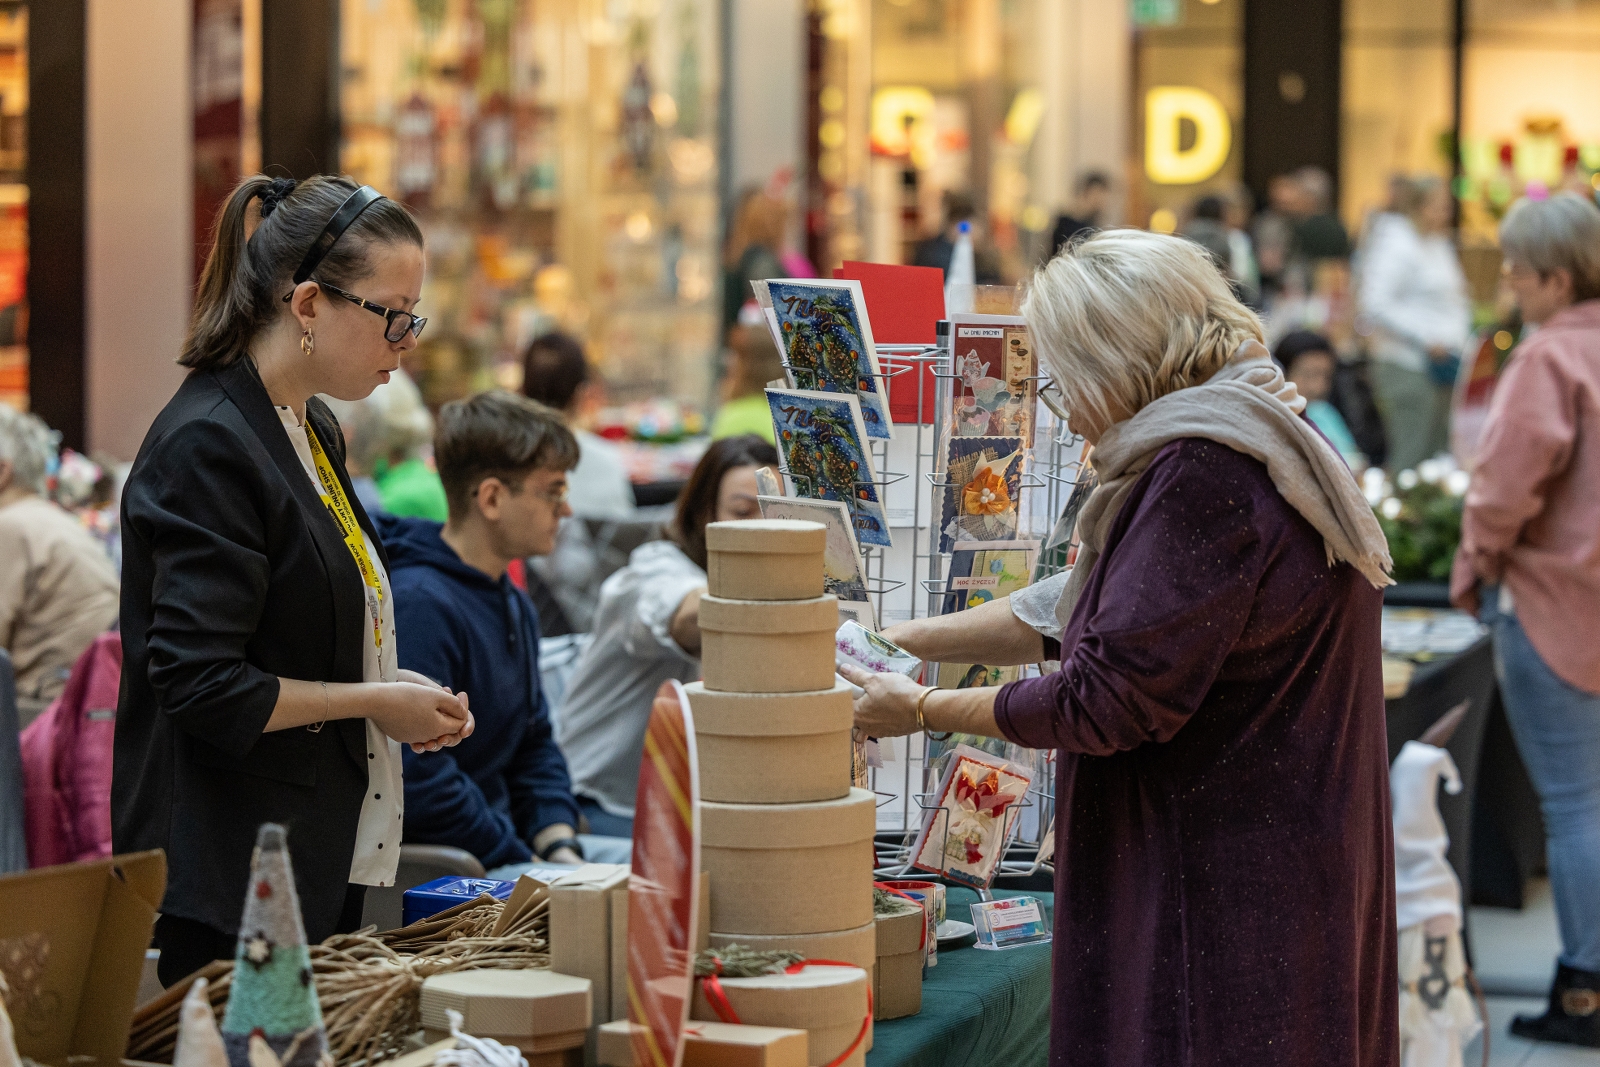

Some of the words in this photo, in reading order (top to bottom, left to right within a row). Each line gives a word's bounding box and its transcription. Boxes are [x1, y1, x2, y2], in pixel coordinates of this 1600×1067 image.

[318, 466, 330, 483] SHOP
[326, 483, 339, 507] ONLINE
[349, 543, 360, 557] NOW
